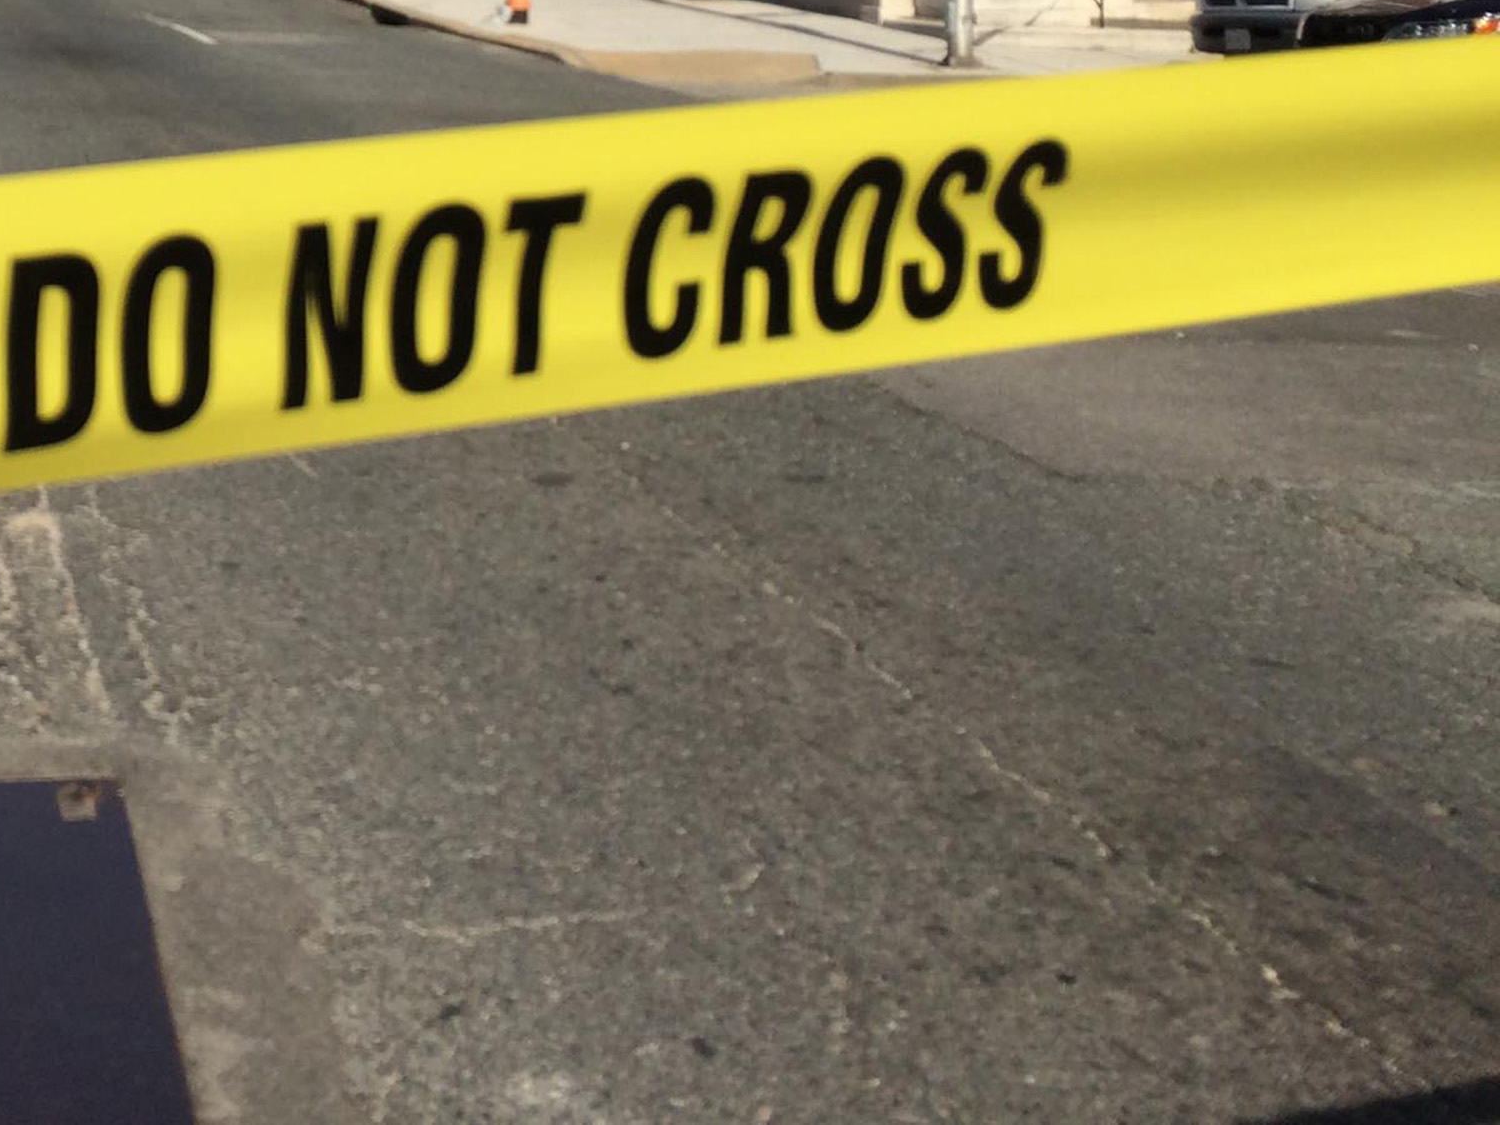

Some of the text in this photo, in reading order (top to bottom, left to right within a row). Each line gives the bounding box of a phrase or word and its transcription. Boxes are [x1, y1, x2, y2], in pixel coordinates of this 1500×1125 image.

[2, 233, 218, 455] DO
[280, 191, 588, 412] NOT
[622, 138, 1070, 361] CROSS
